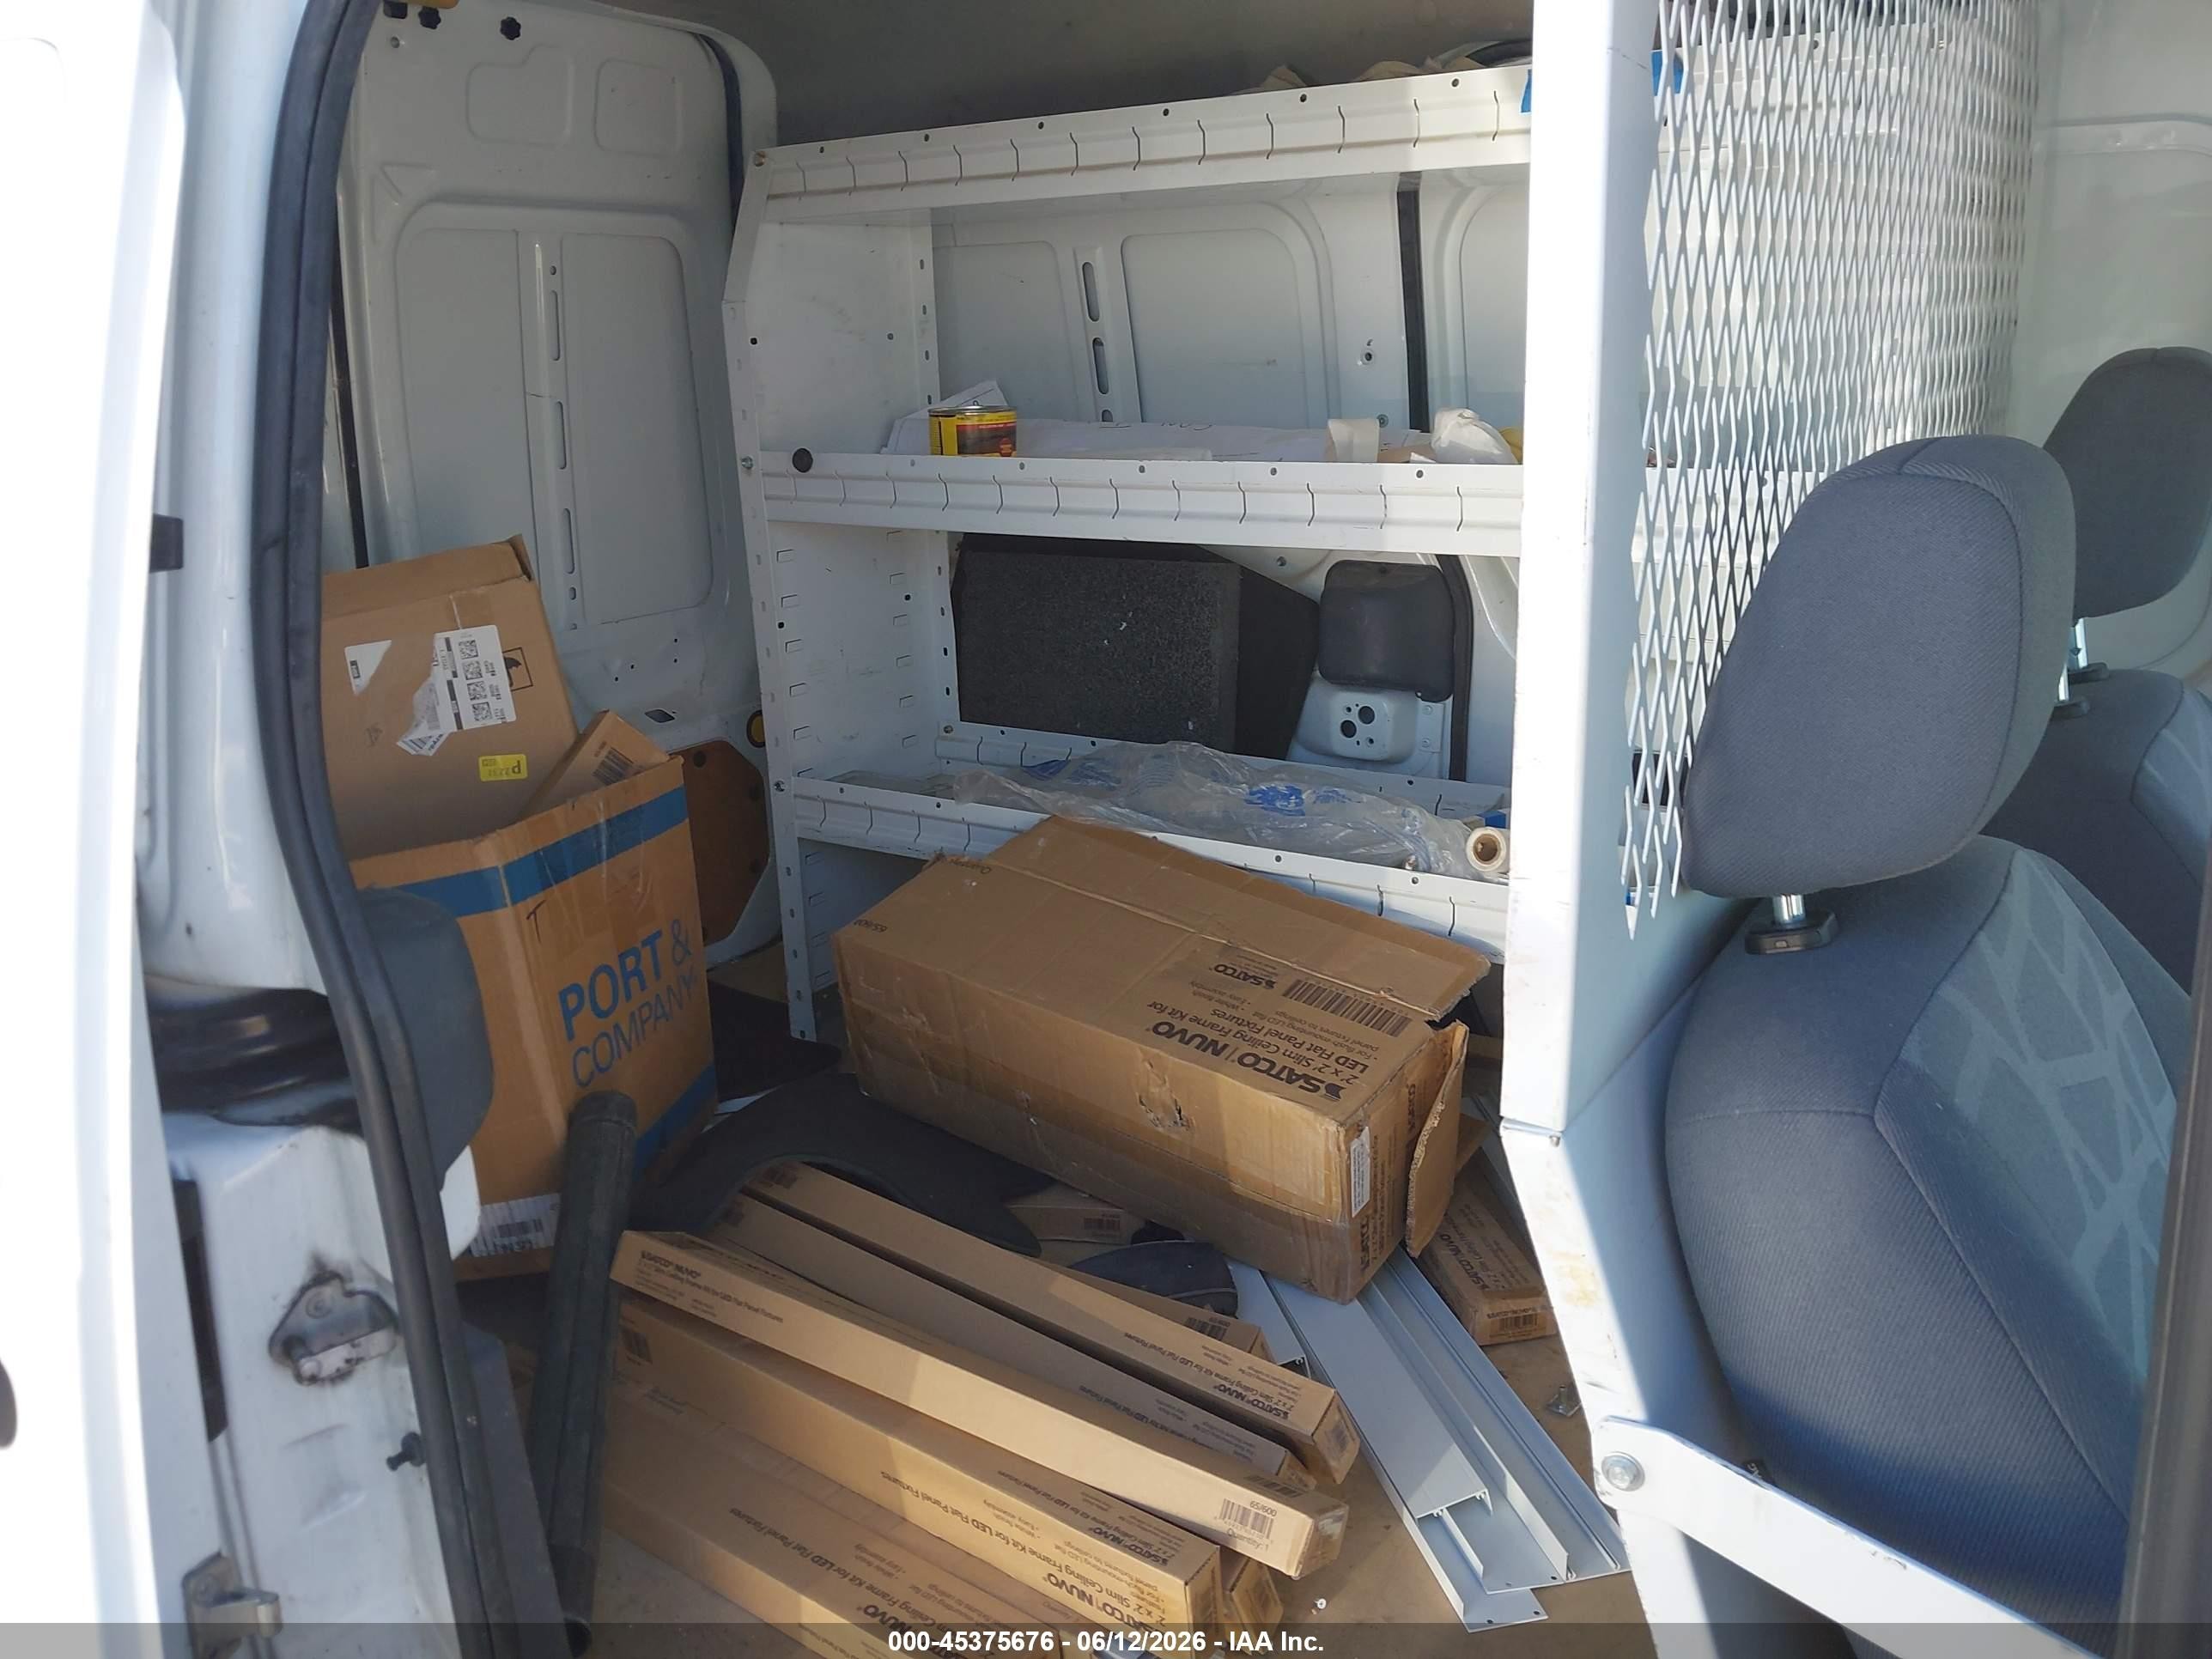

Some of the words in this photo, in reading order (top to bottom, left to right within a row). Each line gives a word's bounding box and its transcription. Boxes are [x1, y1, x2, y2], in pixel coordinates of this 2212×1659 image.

[557, 929, 662, 1042] PORT
[672, 919, 692, 966] &
[1213, 963, 1262, 987] SATCO
[1146, 1001, 1169, 1015] for
[1167, 1007, 1188, 1022] Kit
[573, 963, 697, 1087] COMPANY
[1188, 1015, 1233, 1038] Frame
[1210, 1009, 1266, 1035] Fixtures
[1152, 1021, 1230, 1057] NUVO
[1232, 1030, 1280, 1055] Ceiling
[1263, 1029, 1306, 1050] Panel
[1282, 1048, 1316, 1068] Slim
[1305, 1043, 1335, 1062] Flat
[1237, 1052, 1326, 1094] SATCO
[1335, 1054, 1370, 1074] LED
[1179, 1356, 1194, 1369] LED
[1218, 1383, 1248, 1402] NUVO
[1250, 1398, 1283, 1419] SATCO
[880, 1471, 921, 1498] Fixtures
[921, 1492, 950, 1513] Panel
[1054, 1498, 1070, 1510] LED
[729, 1508, 765, 1533] Fixtures
[949, 1506, 969, 1524] Flat
[971, 1518, 994, 1536] LED
[1092, 1527, 1125, 1547] NUVO
[763, 1528, 792, 1548] Panel
[995, 1530, 1011, 1545] for
[1011, 1538, 1027, 1553] Kit
[791, 1545, 811, 1561] Flat
[810, 1555, 835, 1571] LED
[1028, 1547, 1063, 1573] Frame
[1127, 1543, 1162, 1563] SATCO
[833, 1566, 851, 1580] for
[848, 1574, 866, 1589] Kit
[1064, 1564, 1103, 1594] Ceiling
[865, 1583, 899, 1608] Frame
[1046, 1572, 1094, 1607] NUVO
[1105, 1587, 1131, 1608] Slim
[898, 1601, 937, 1628] Ceiling
